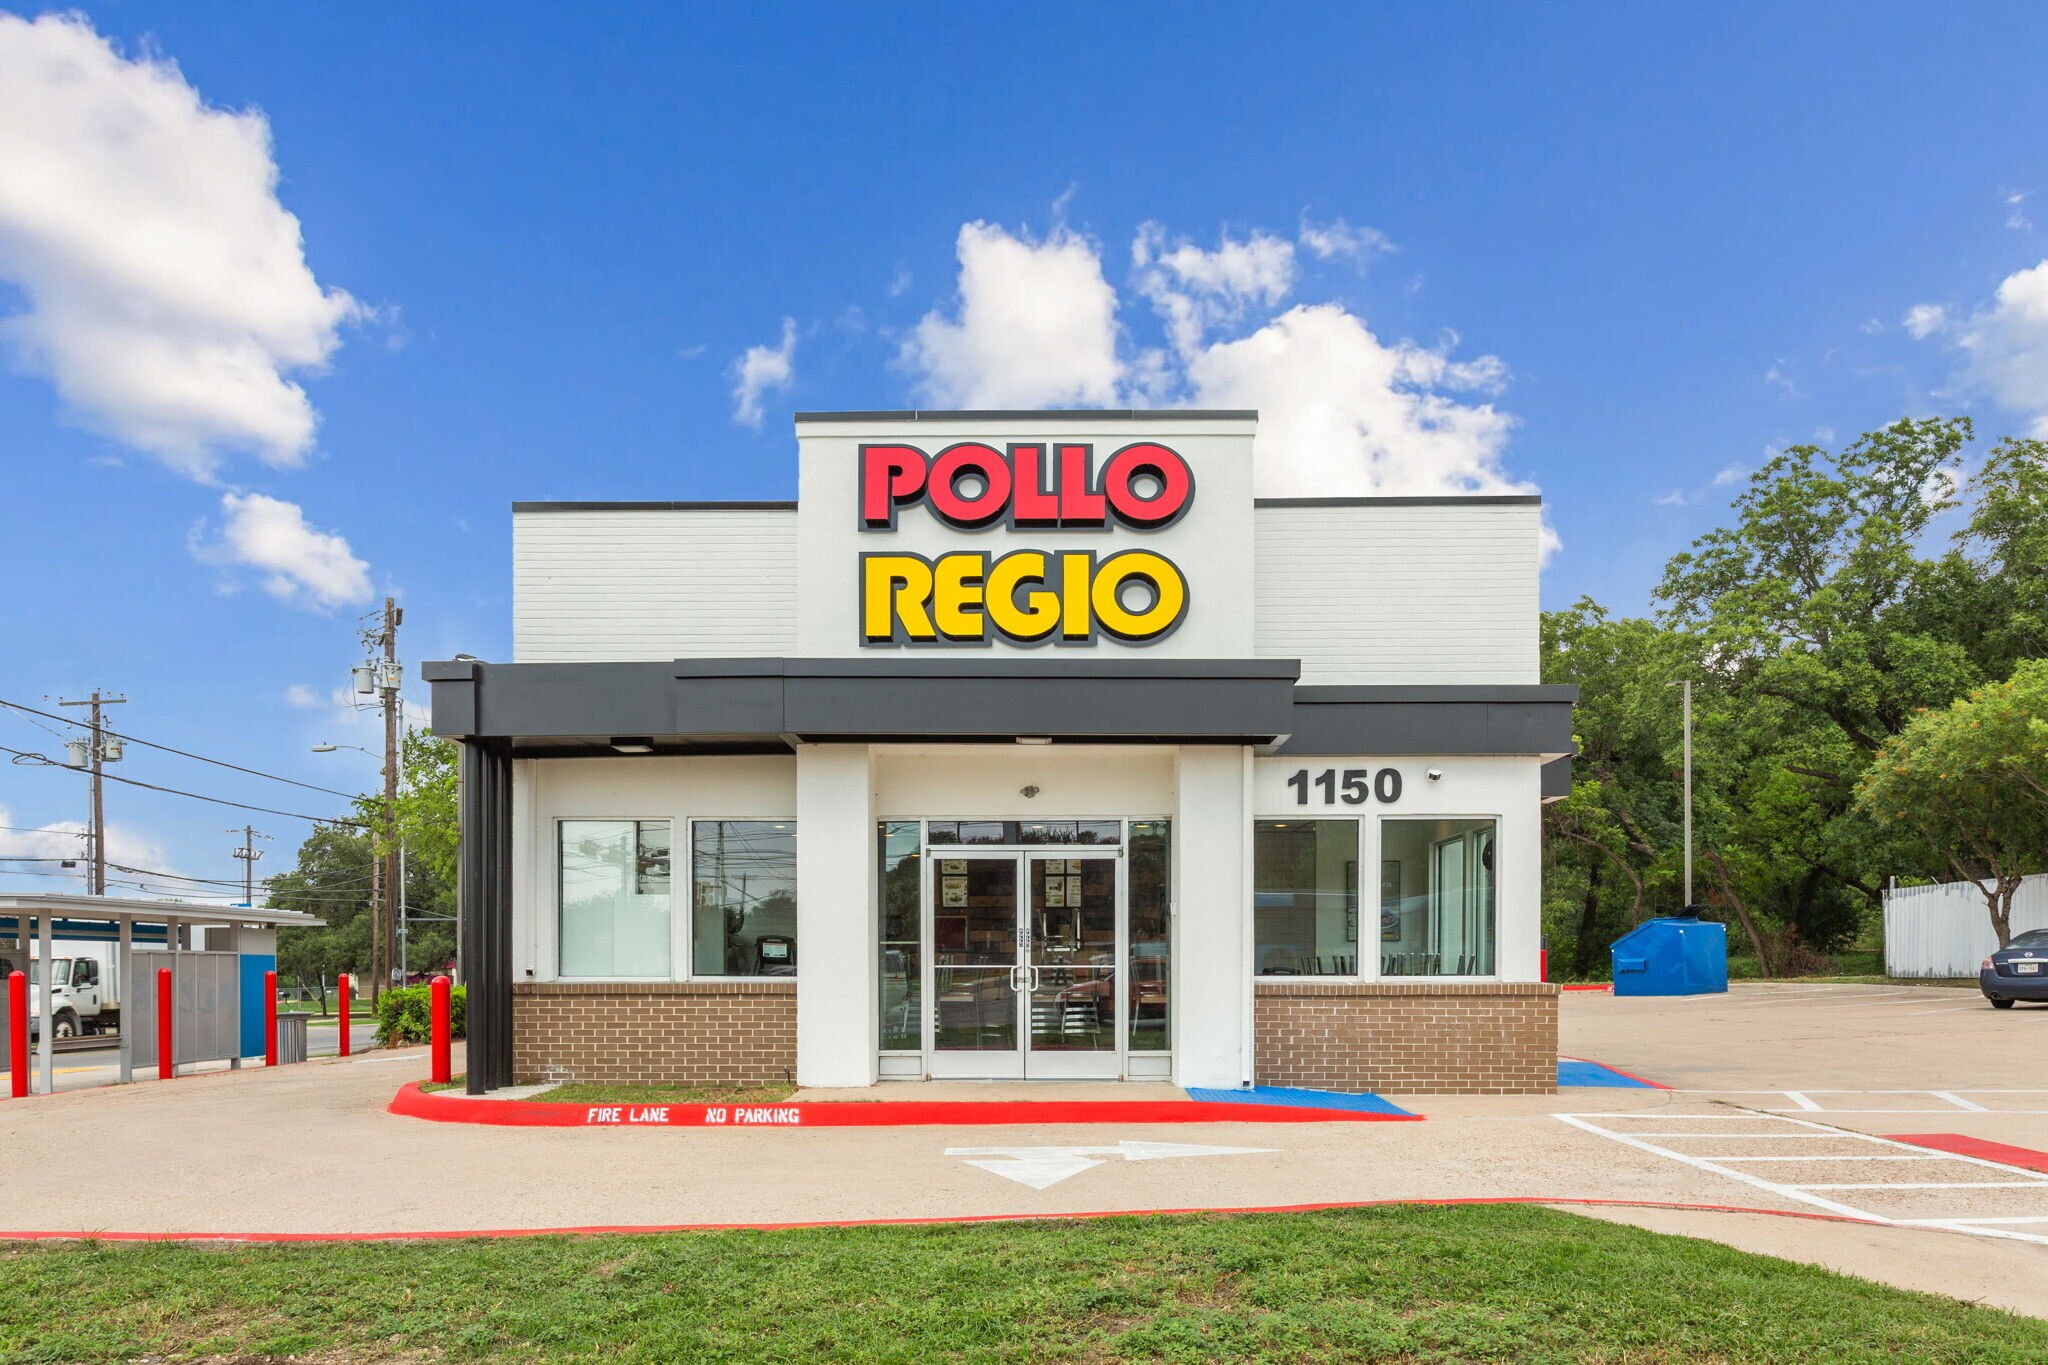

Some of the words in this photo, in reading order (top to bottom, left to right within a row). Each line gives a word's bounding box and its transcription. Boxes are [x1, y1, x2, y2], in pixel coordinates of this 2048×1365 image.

[861, 443, 1192, 530] POLLO
[861, 551, 1188, 645] REGIO
[1288, 768, 1402, 804] 1150
[587, 1107, 622, 1123] FIRE
[629, 1107, 670, 1122] LANE
[705, 1108, 727, 1123] NO
[735, 1107, 800, 1123] PARKING
